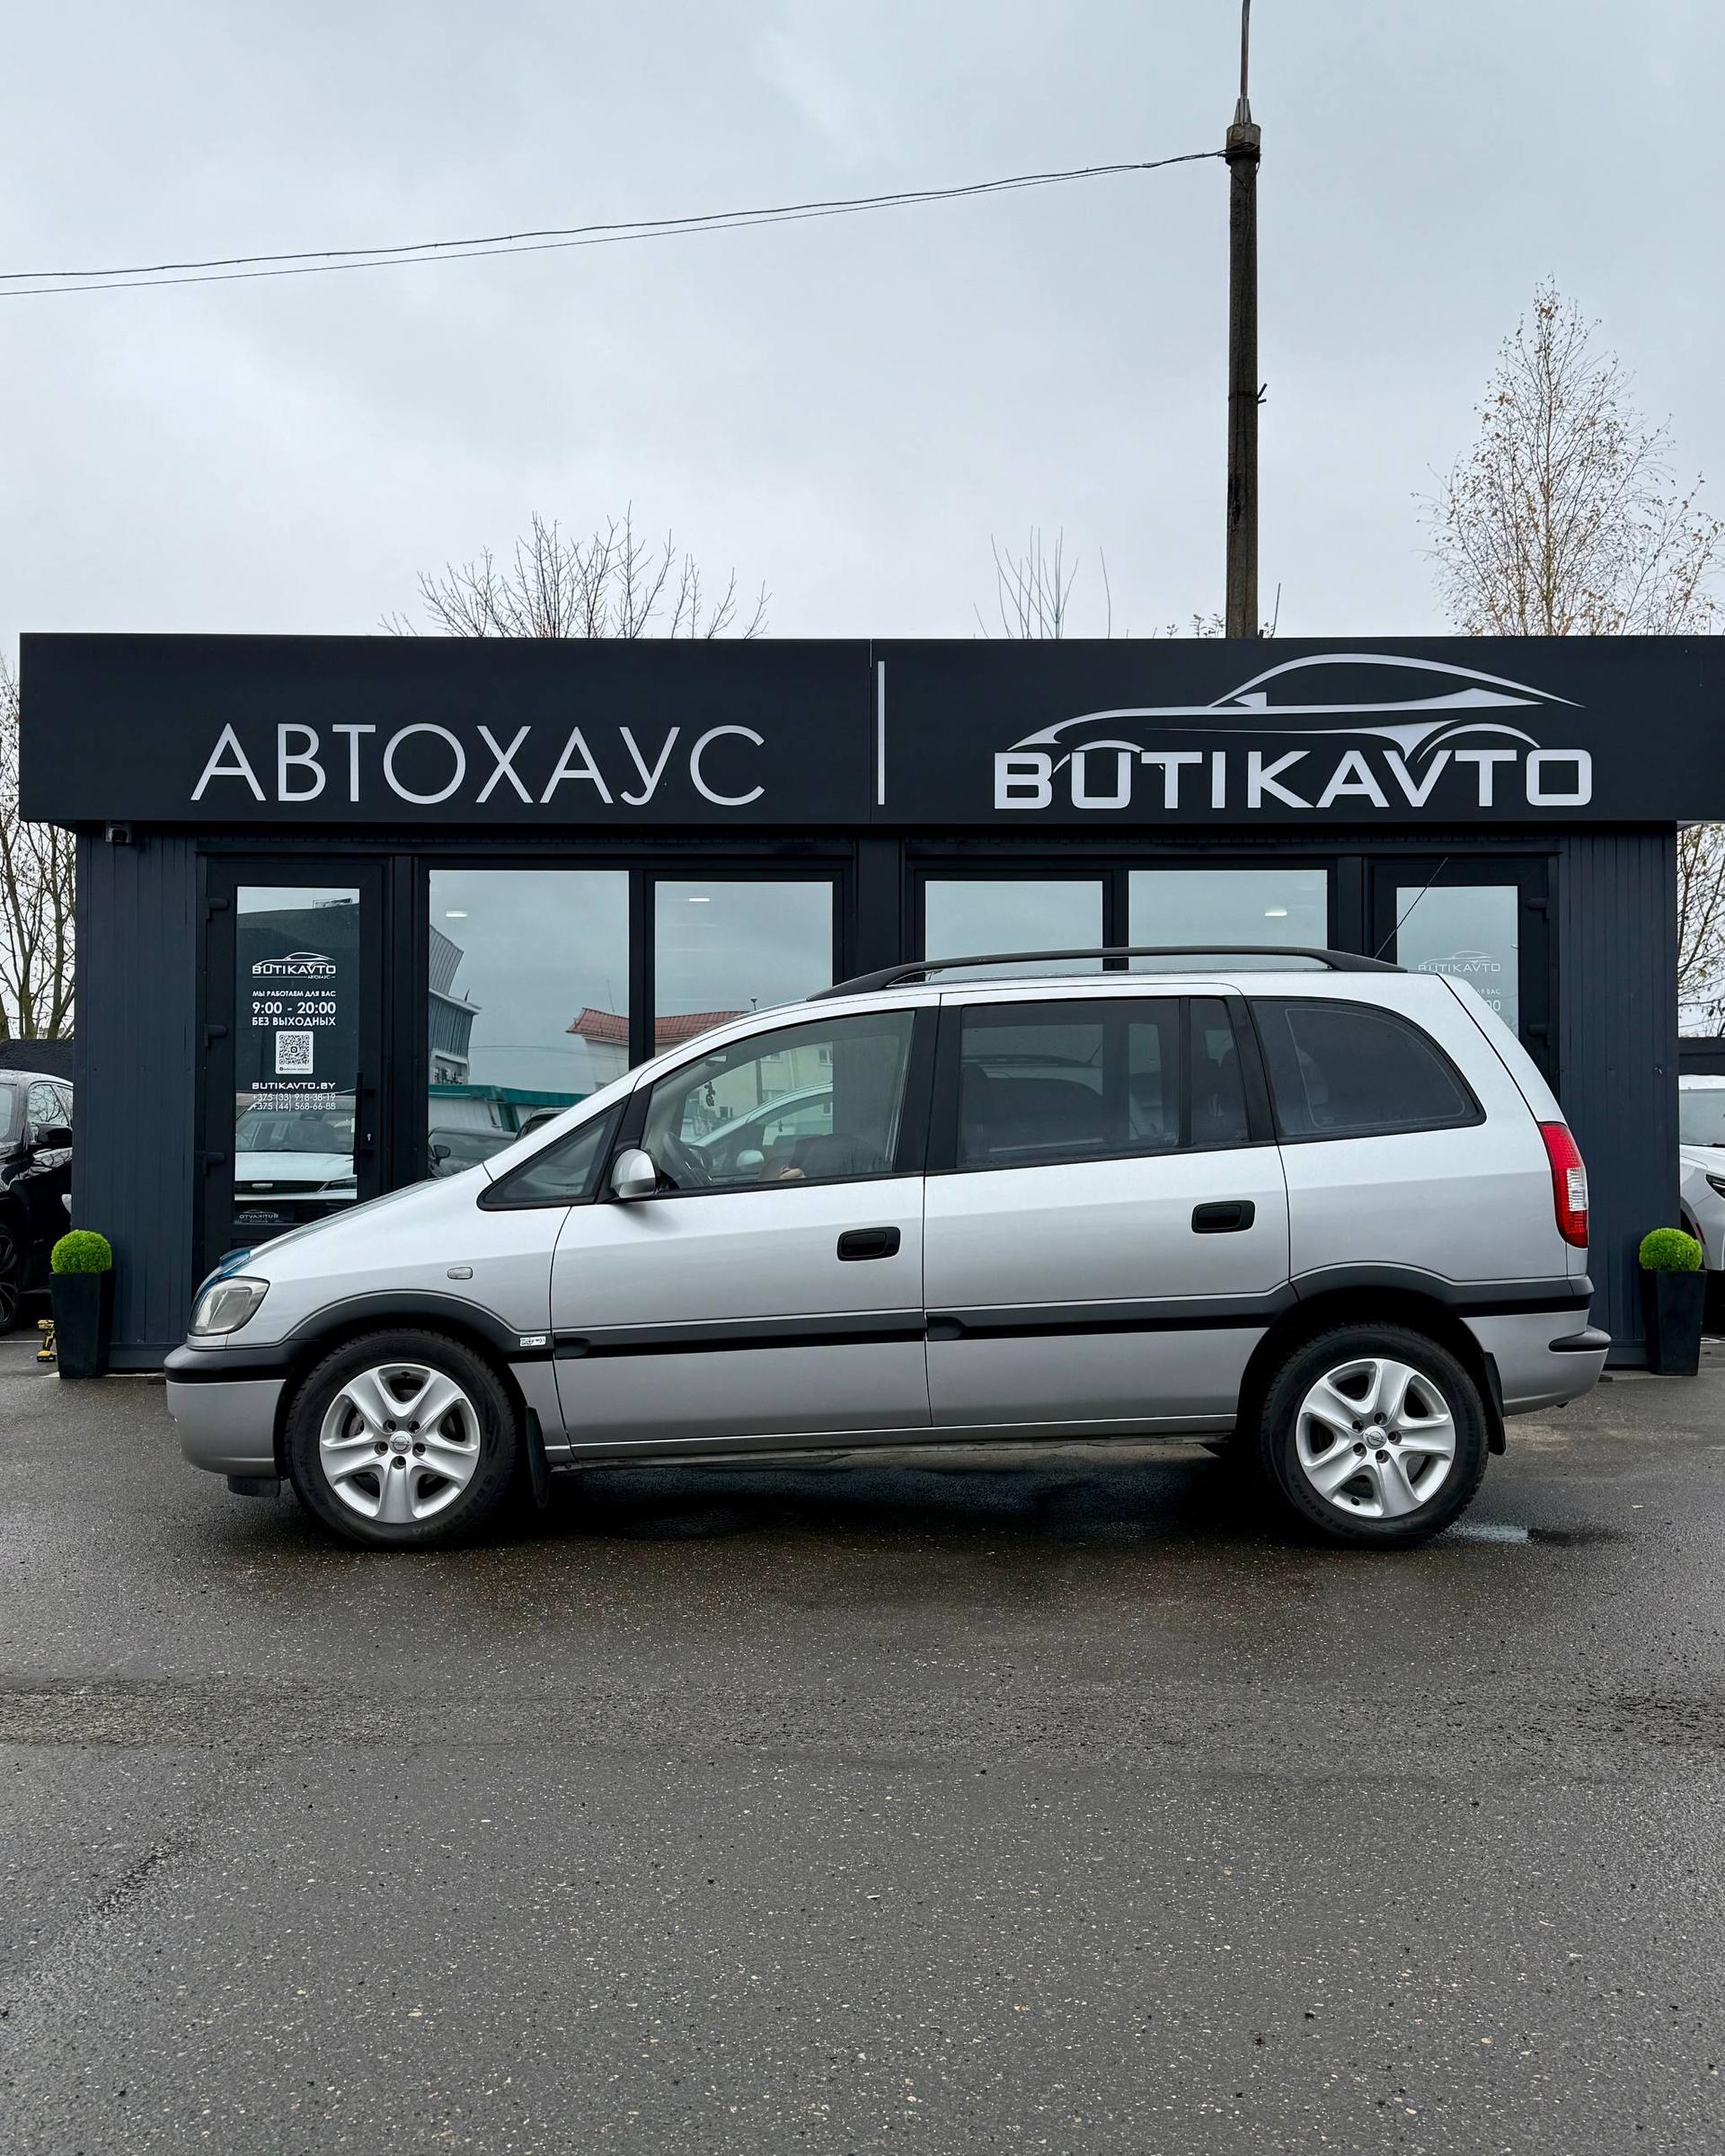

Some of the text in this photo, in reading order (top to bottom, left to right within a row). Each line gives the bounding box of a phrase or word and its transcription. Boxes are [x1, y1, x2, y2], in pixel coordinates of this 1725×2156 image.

[190, 722, 766, 806] АВТОХАУС
[994, 747, 1593, 810] BUTIKAVTO
[252, 965, 336, 974] BUTIKAVTO
[252, 1002, 282, 1014] 9:00
[296, 1002, 336, 1014] 20:00
[252, 1017, 336, 1027] БЕЗ ВЫХОДНЫХ
[252, 1082, 336, 1090] BUTIKAVTO.BY
[252, 1093, 273, 1101] +375
[294, 1093, 336, 1101] 918-38-19
[275, 1101, 292, 1112] (44)
[294, 1102, 336, 1110] 568-66-88
